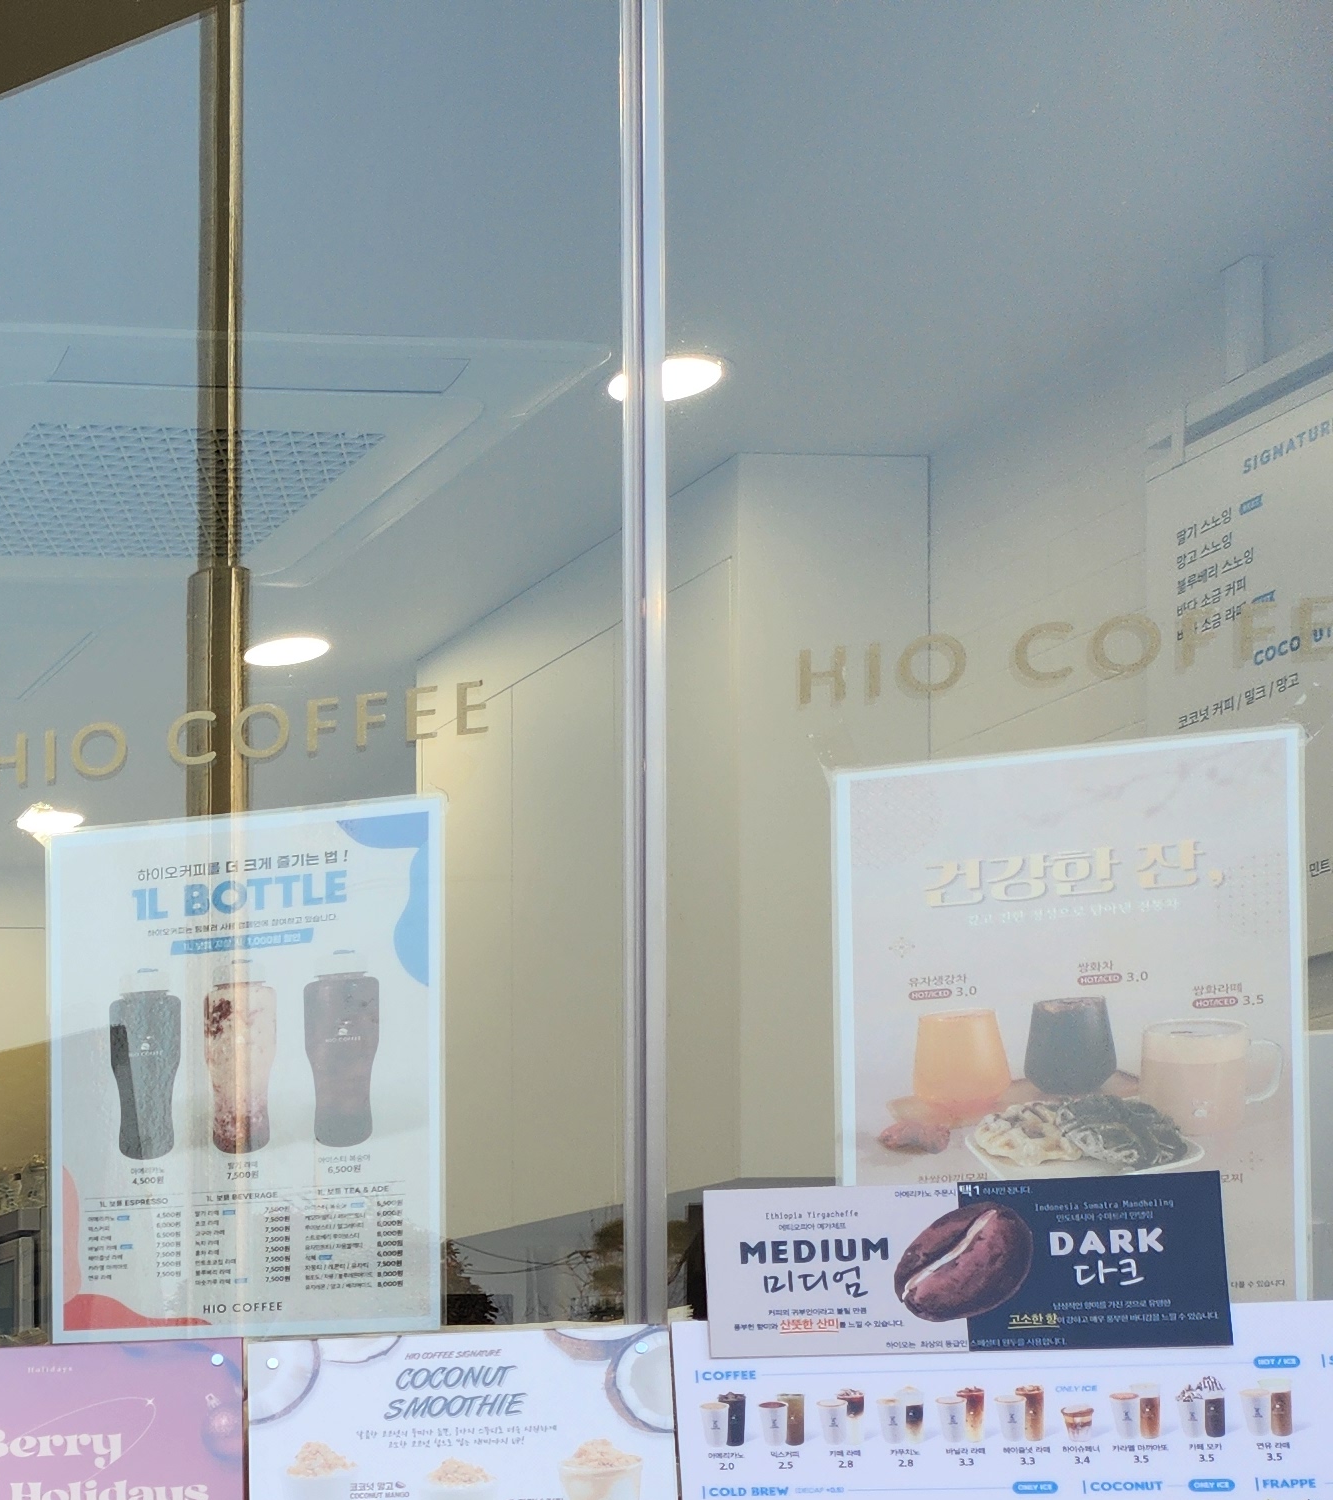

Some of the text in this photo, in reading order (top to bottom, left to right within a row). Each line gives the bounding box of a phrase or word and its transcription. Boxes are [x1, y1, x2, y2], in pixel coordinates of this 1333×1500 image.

[797, 595, 1333, 706] HIO COFFE
[167, 680, 489, 765] COFFEE
[244, 857, 272, 872] 크게
[277, 853, 319, 869] 즐기는
[923, 846, 1121, 909] 건강한
[132, 870, 348, 921] 1L BOTTLE
[1126, 971, 1148, 983] 3.0
[1243, 995, 1263, 1006] 3.5
[1035, 1200, 1174, 1212] Indonesia Sumatra Mandheling
[1049, 1227, 1164, 1256] DARK
[740, 1238, 889, 1264] MEDIUM
[1074, 1259, 1144, 1285] 다크
[763, 1266, 868, 1298] 미디엄
[203, 1301, 282, 1315] HIO COFFEE
[780, 1320, 813, 1331] 산뜻한
[395, 1365, 518, 1391] COCONUT
[702, 1370, 756, 1381] COFFEE
[384, 1393, 528, 1421] SMOOTHIE
[719, 1462, 734, 1470] 2.0
[778, 1461, 793, 1469] 2.5
[838, 1460, 853, 1468] 2.8
[1090, 1482, 1162, 1492] COCONUT
[1263, 1479, 1316, 1488] FRAPPE
[709, 1487, 789, 1496] COLD BREW
